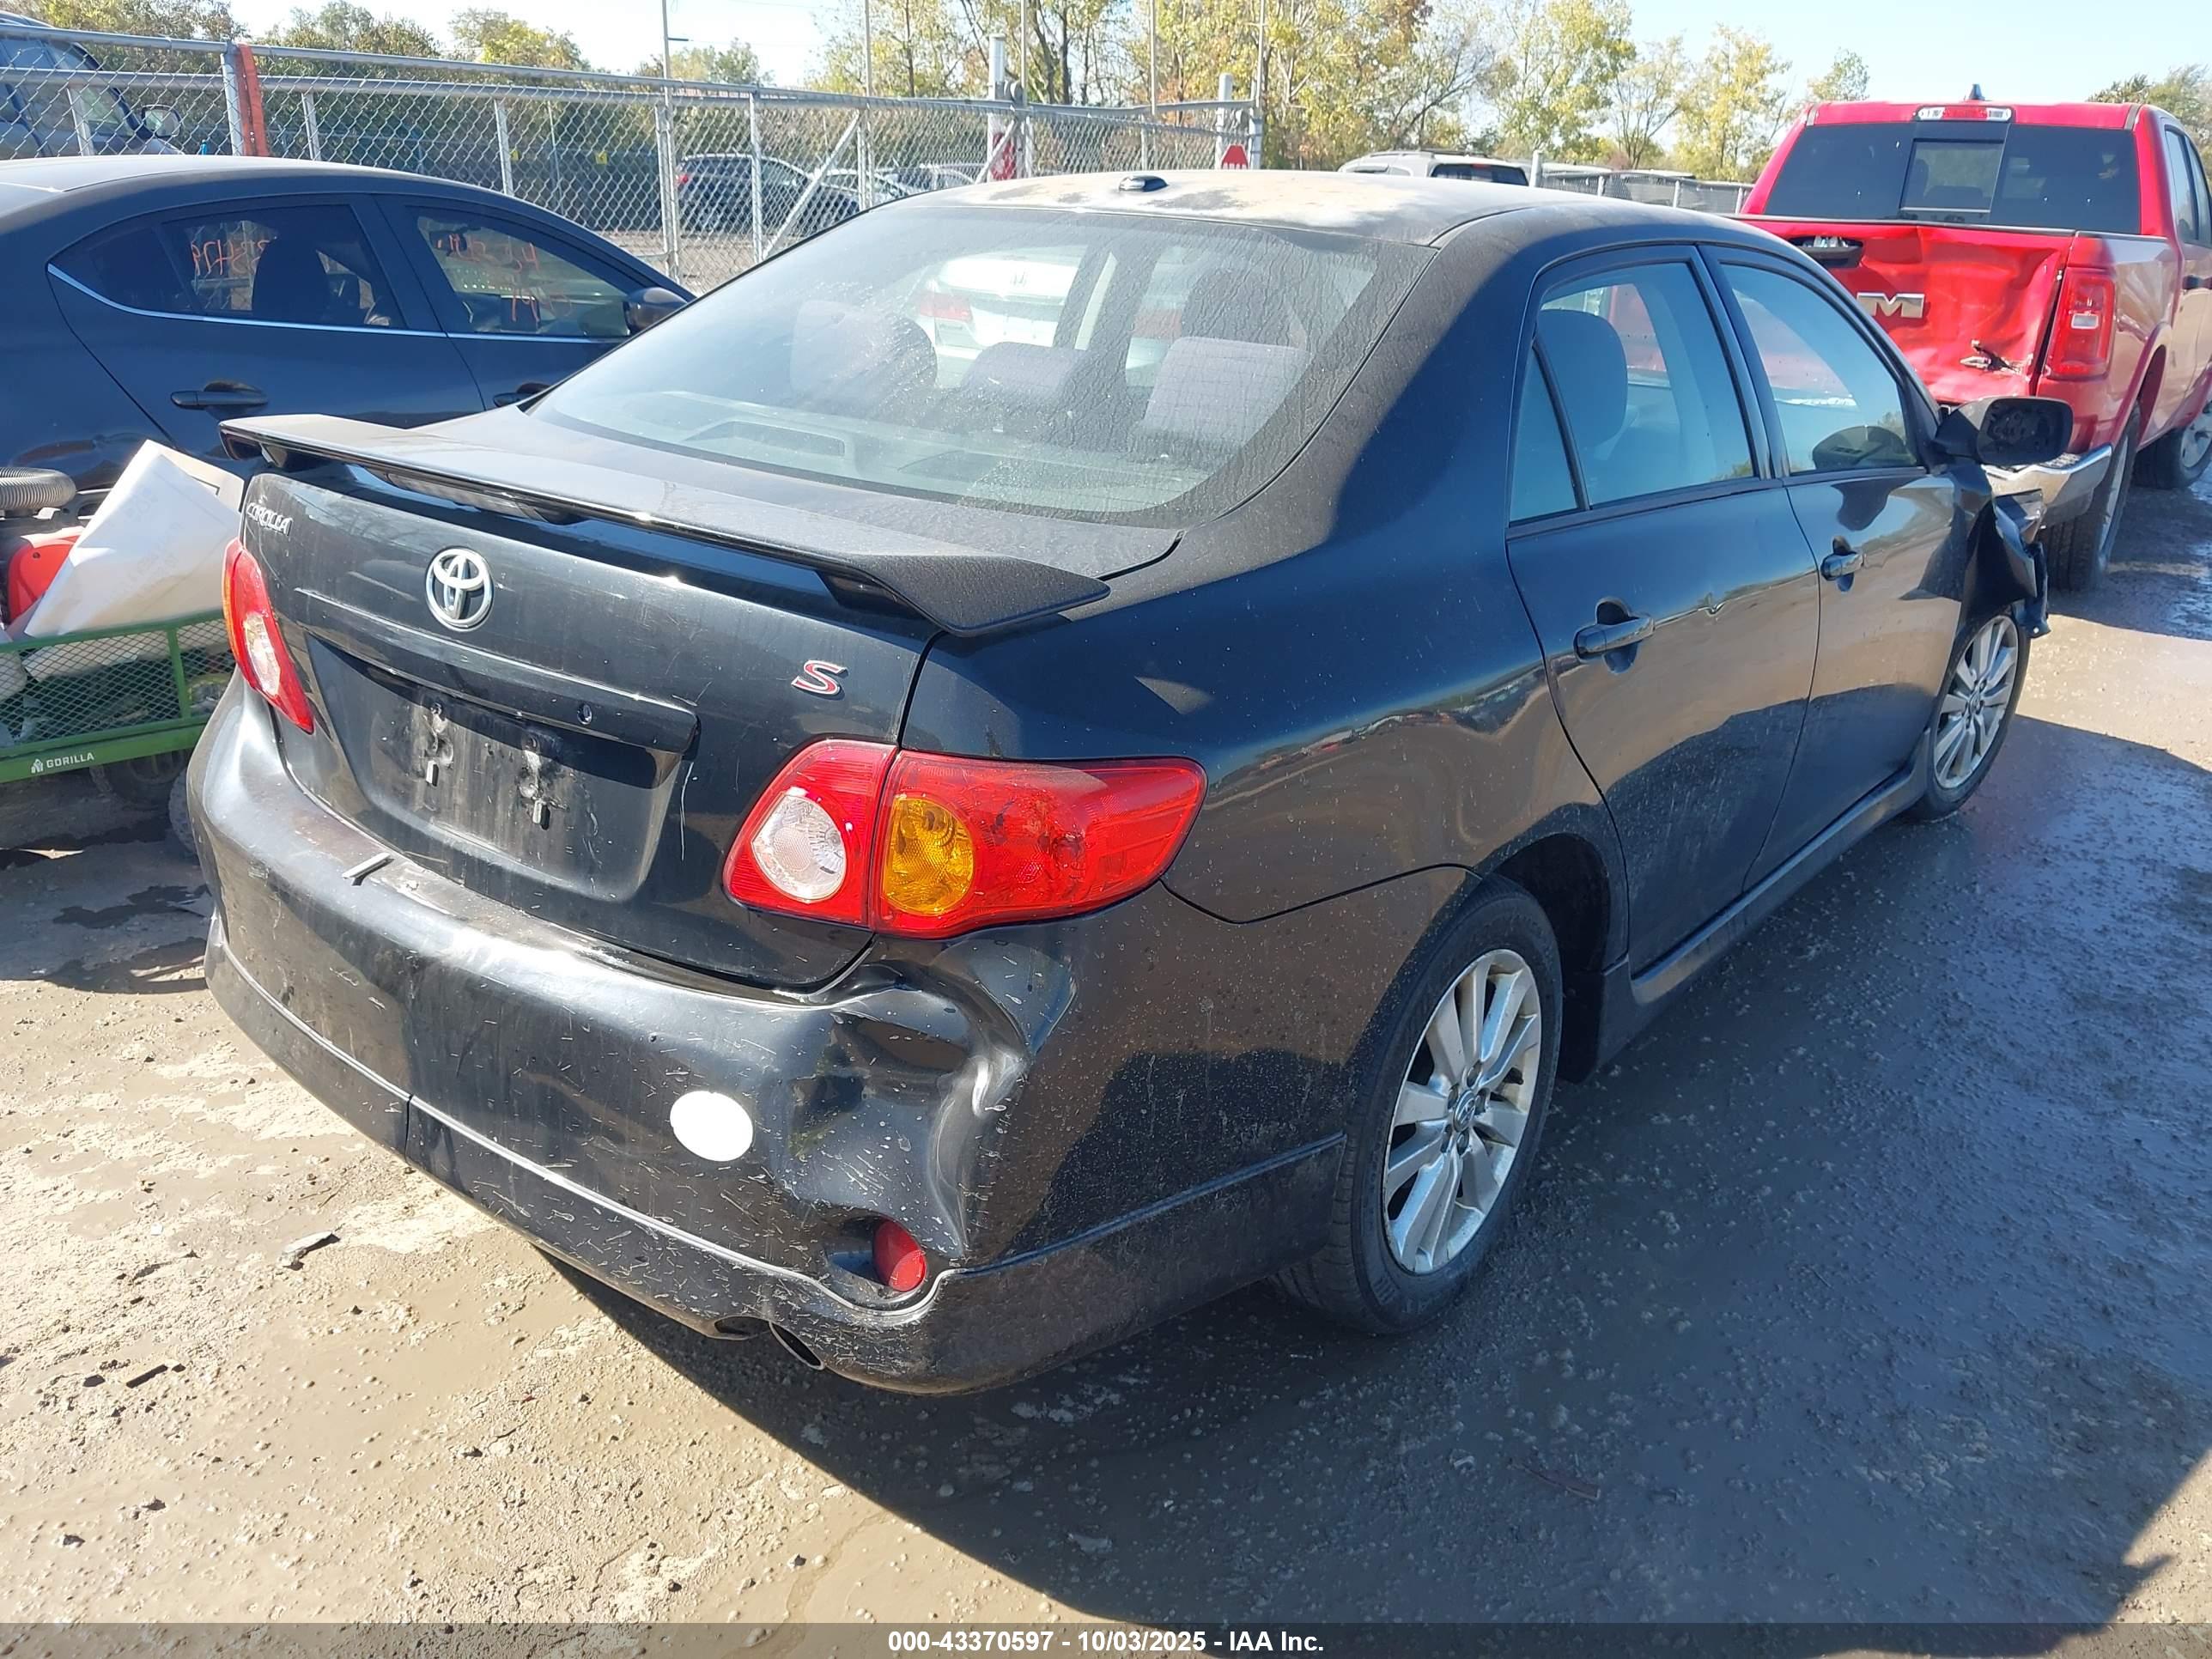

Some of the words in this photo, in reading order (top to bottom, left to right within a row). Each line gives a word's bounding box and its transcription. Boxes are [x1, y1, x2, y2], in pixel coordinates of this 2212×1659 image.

[246, 501, 294, 536] COROLLA
[790, 659, 848, 696] S
[46, 752, 94, 769] GORILLA
